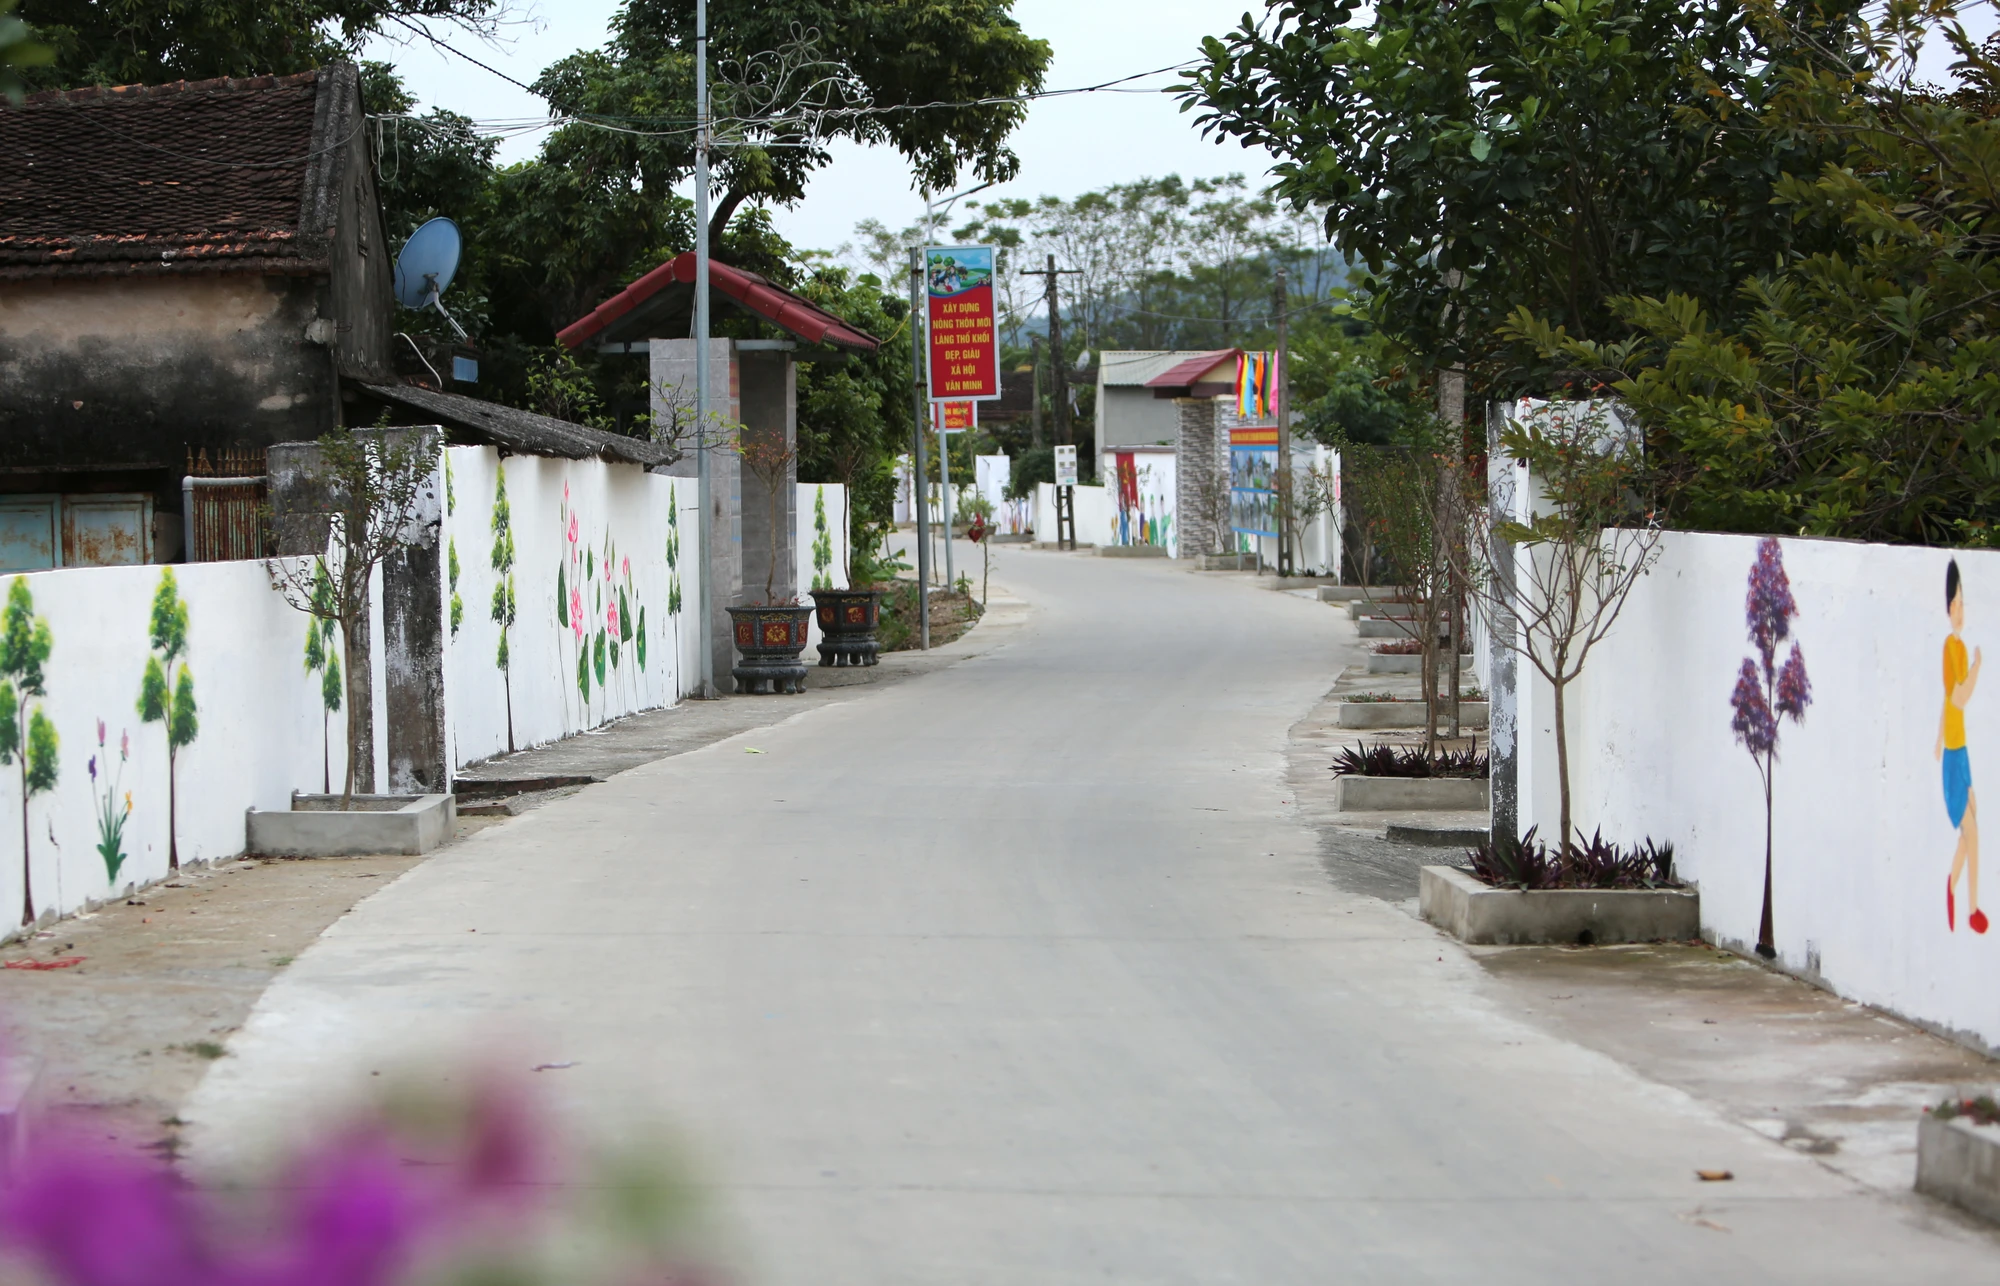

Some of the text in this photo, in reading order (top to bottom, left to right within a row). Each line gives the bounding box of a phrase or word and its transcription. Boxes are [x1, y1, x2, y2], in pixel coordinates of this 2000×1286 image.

[943, 302, 980, 314] XÂY DỰNG
[932, 318, 954, 329] NÔNG
[955, 317, 975, 328] THÔN
[962, 347, 980, 359] GIÀU
[963, 363, 976, 376] HỘI
[962, 380, 983, 390] MINH
